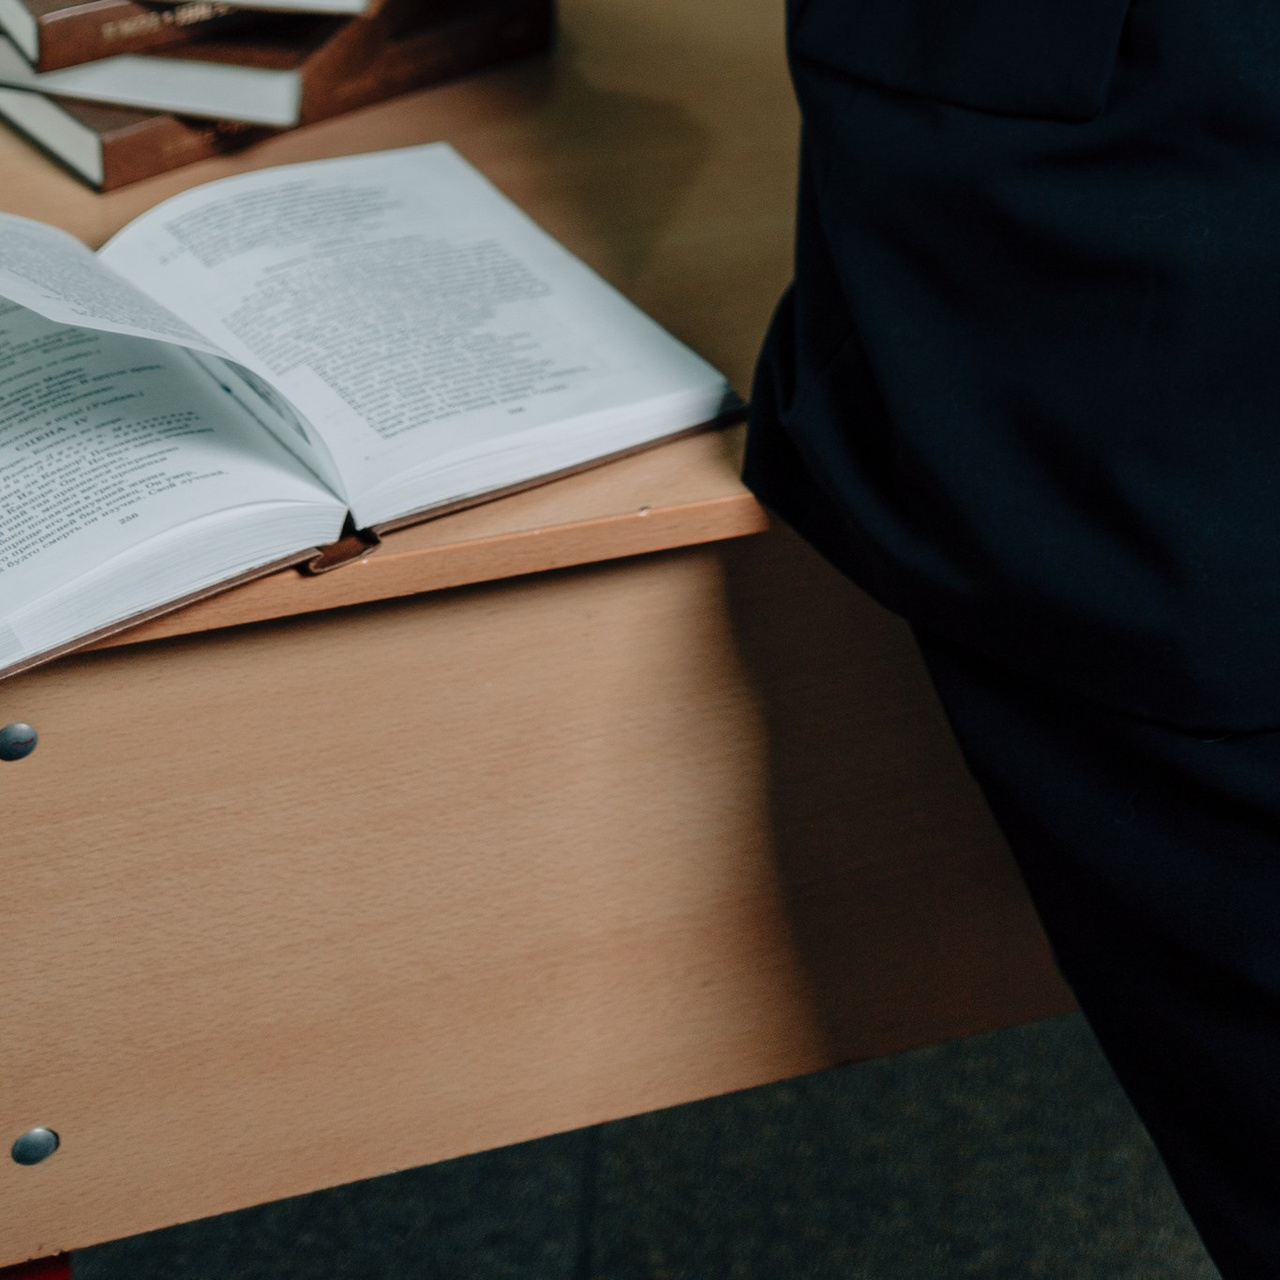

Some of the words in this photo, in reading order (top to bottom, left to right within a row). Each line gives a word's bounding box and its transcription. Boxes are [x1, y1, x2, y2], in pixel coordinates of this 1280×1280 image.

[15, 426, 66, 451] СЦЕНА
[73, 416, 88, 427] IV
[7, 487, 58, 515] Кавдора.
[60, 477, 76, 487] Он
[25, 479, 38, 490] ли
[31, 498, 50, 511] тан
[53, 468, 111, 500] признался
[38, 479, 55, 490] нет
[45, 518, 63, 530] его
[66, 487, 125, 518] минувшей
[129, 471, 166, 488] жизни
[7, 547, 40, 568] будто
[42, 526, 81, 549] смерть
[84, 516, 98, 527] он
[101, 495, 146, 517] изучил.
[148, 482, 177, 497] Свой
[8, 515, 39, 532] вине,
[42, 493, 77, 513] молил
[81, 483, 98, 494] вас
[11, 518, 77, 557] прекрасней
[79, 506, 102, 520] был
[105, 489, 143, 507] конец.
[145, 479, 162, 490] Он
[165, 470, 197, 483] умер,
[28, 500, 80, 531] покаялся
[118, 512, 139, 525] 256
